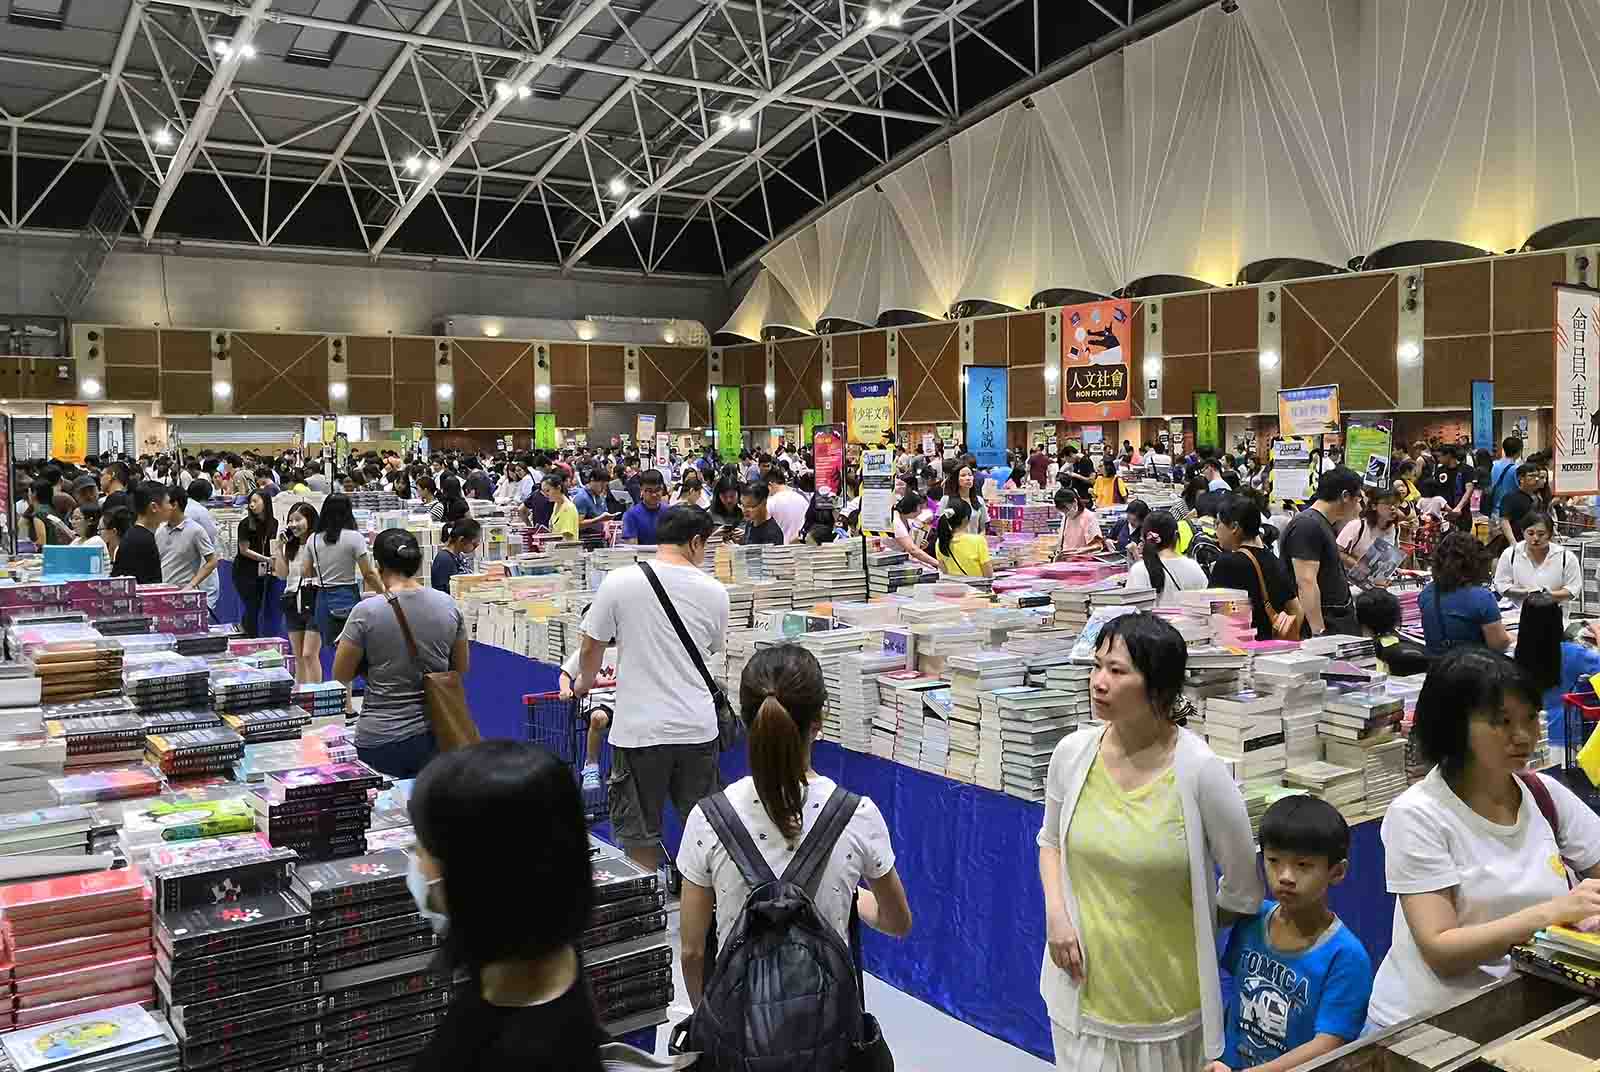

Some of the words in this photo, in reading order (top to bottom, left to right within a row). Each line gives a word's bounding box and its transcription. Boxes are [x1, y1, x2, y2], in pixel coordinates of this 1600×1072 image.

[1069, 368, 1124, 391] 人文社會
[1091, 389, 1118, 397] FICTION
[1570, 307, 1588, 456] 會員專區
[1240, 951, 1311, 1005] TOMICA
